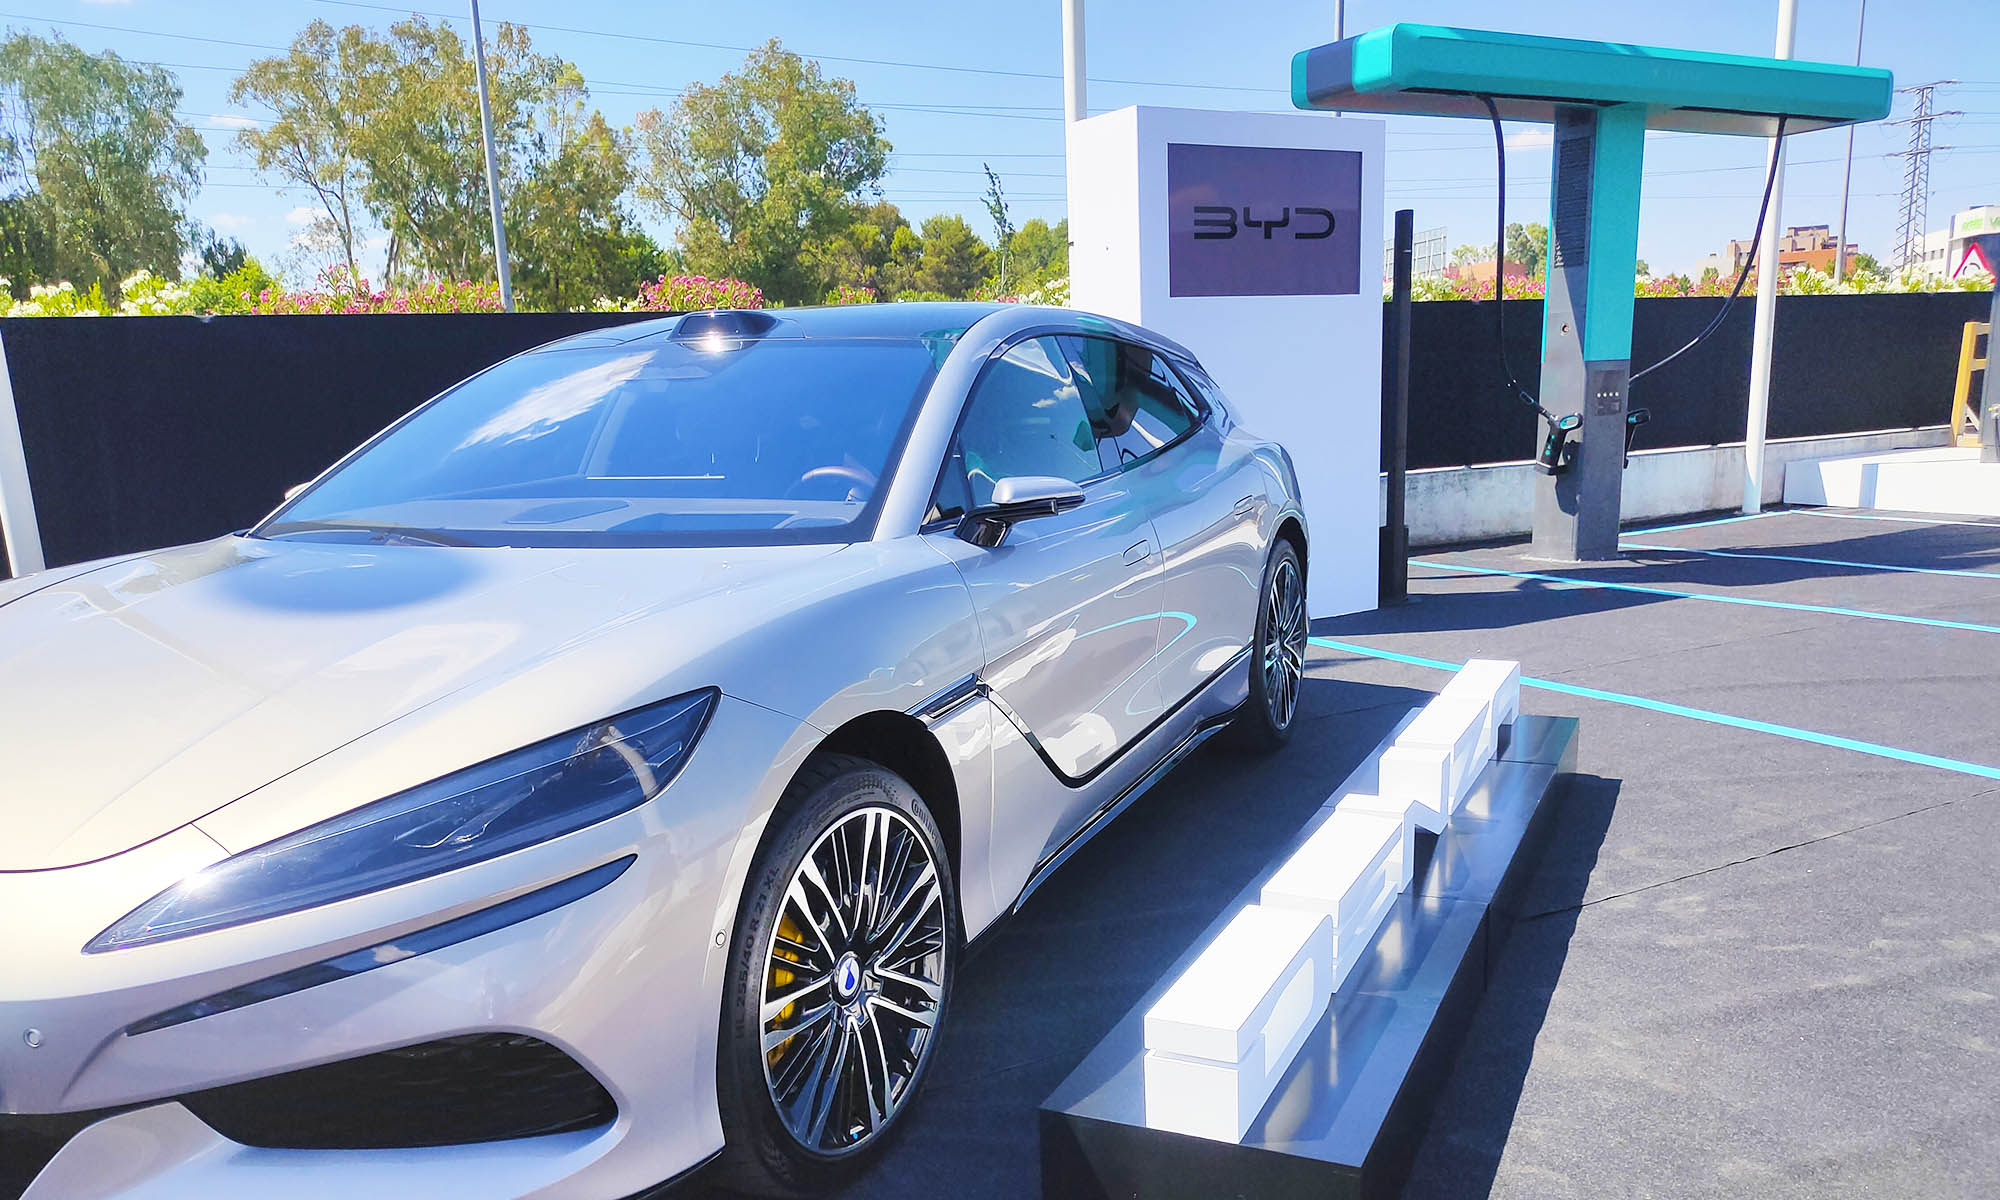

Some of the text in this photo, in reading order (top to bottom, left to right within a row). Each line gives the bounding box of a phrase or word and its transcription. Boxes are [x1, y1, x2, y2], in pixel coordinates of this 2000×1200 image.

[1193, 206, 1336, 240] BYD
[763, 866, 781, 891] XL
[754, 894, 768, 915] 21
[749, 917, 760, 933] R
[736, 934, 755, 1009] 255/40
